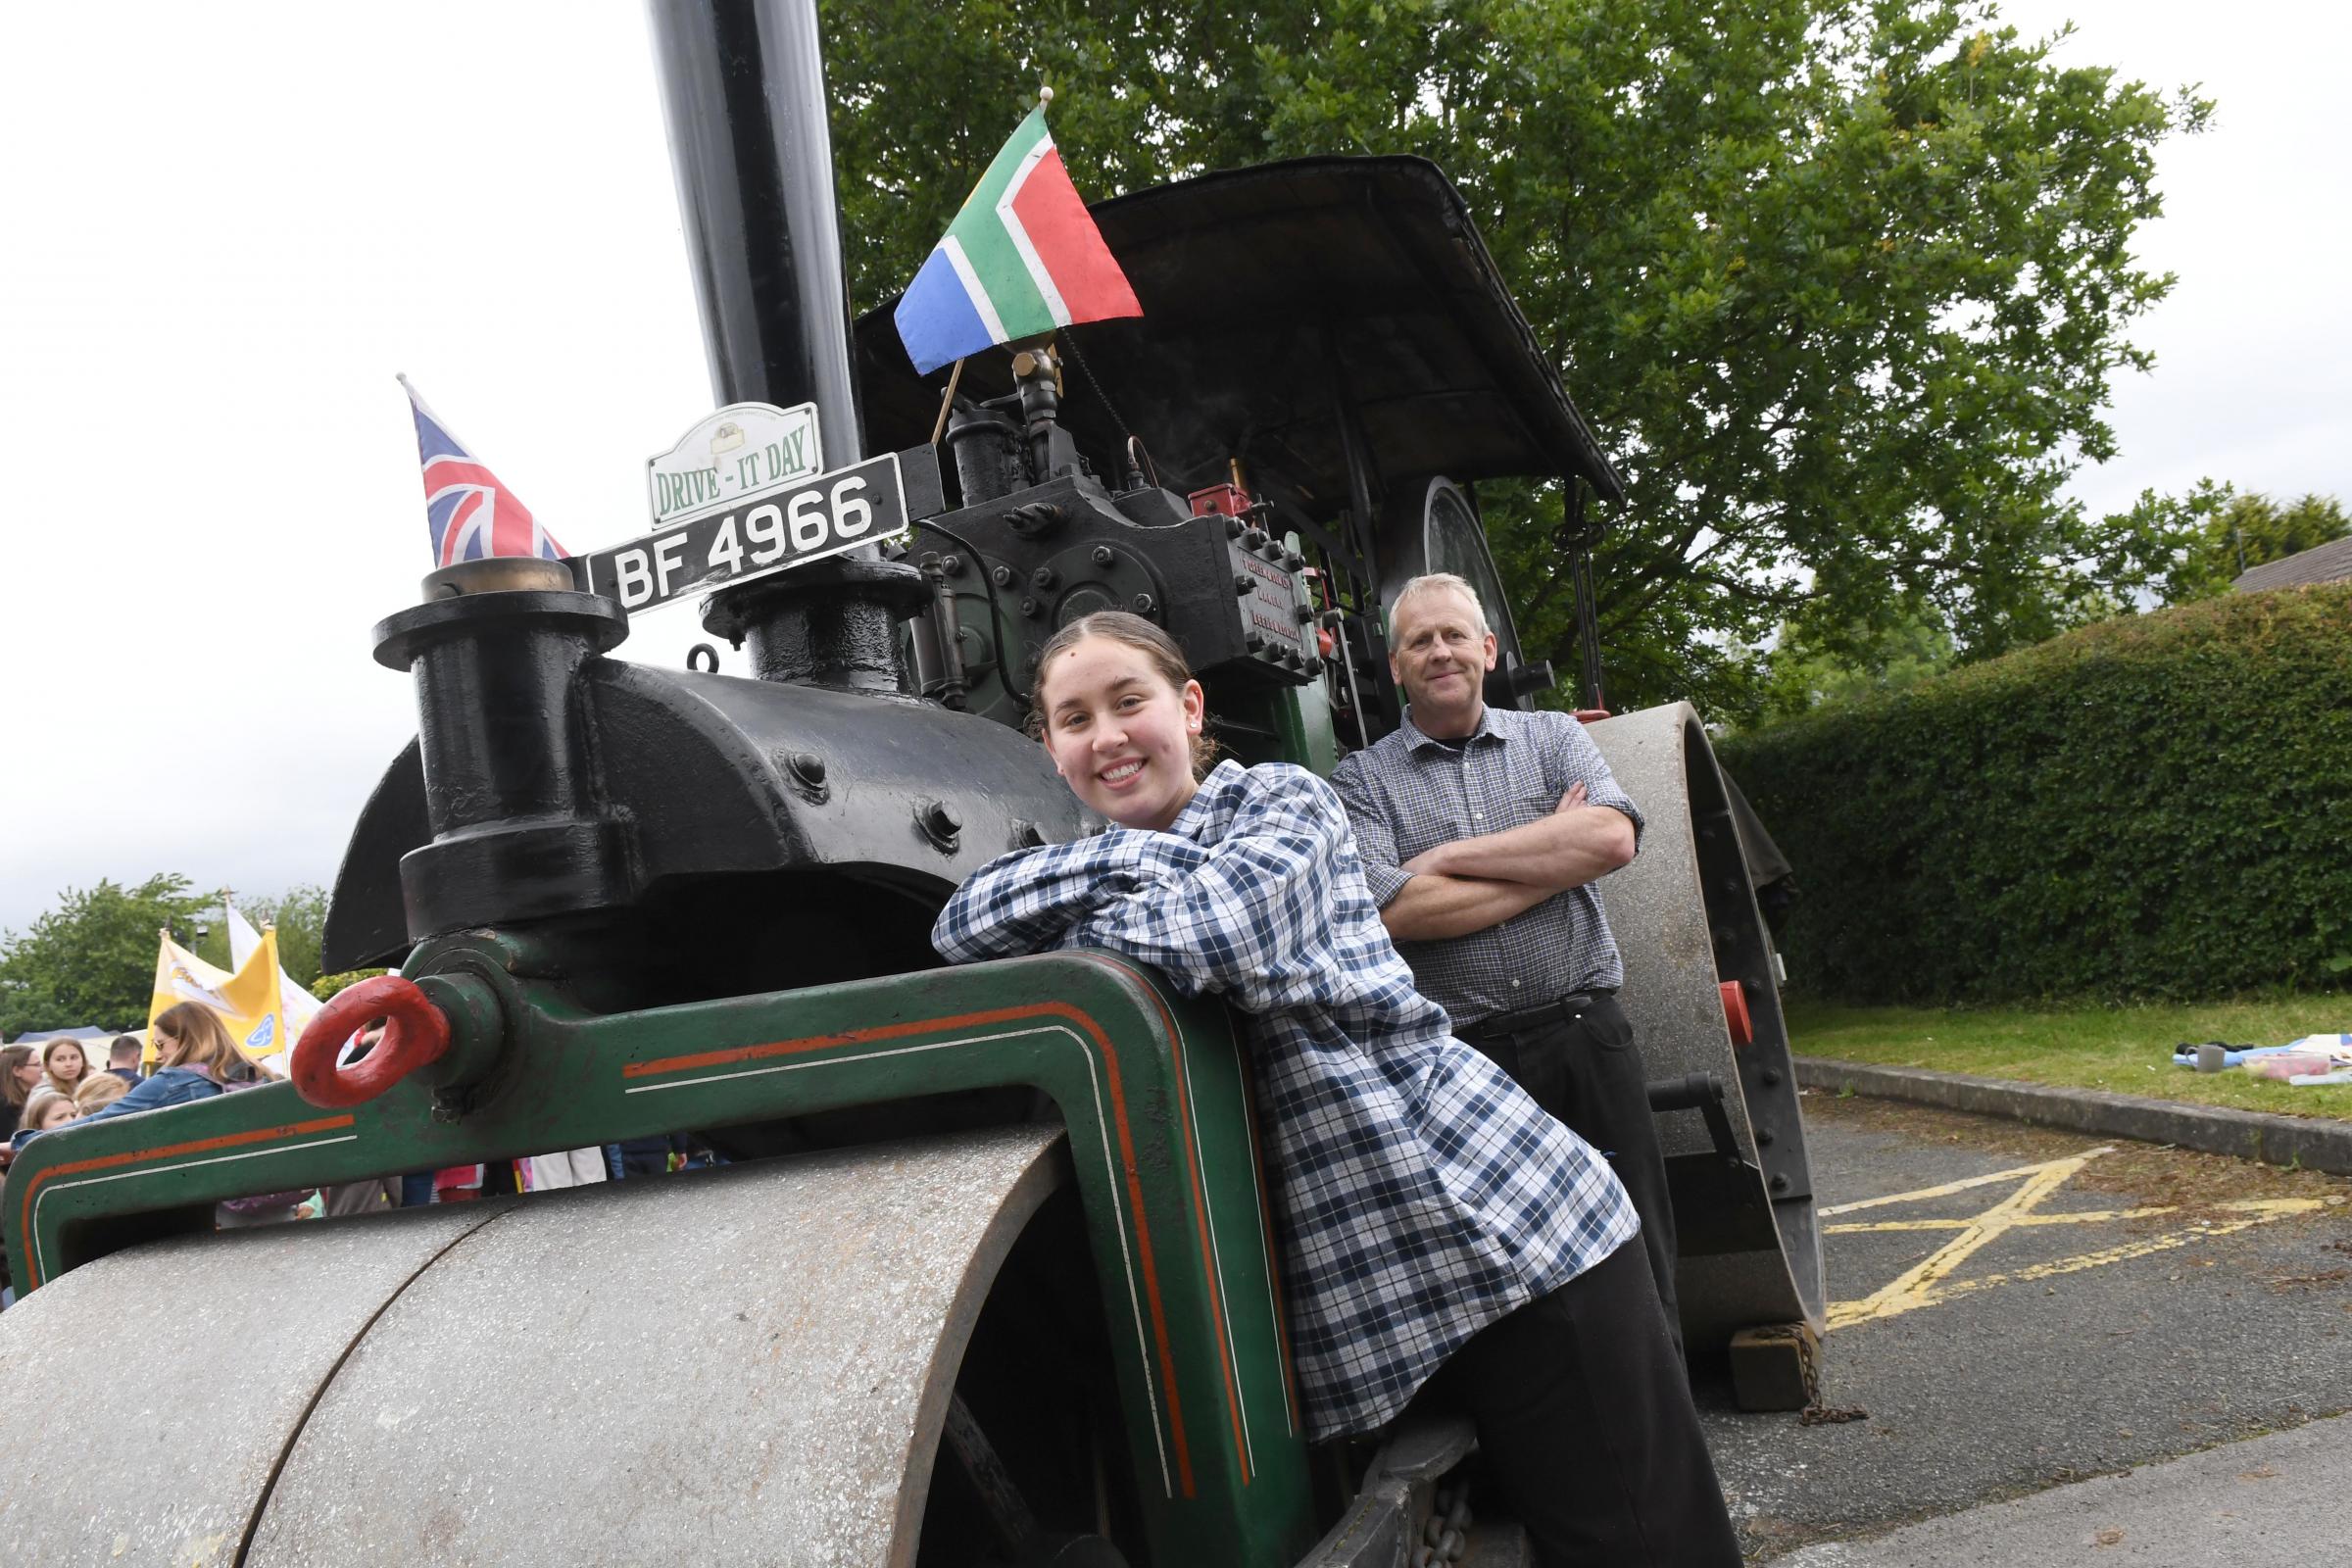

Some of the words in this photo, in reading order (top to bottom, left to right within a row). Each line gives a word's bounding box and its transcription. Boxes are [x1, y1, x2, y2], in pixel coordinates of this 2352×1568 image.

[656, 466, 719, 516] DRIVE
[736, 452, 760, 490] IT
[765, 424, 806, 480] DAY
[614, 532, 688, 609] BF
[708, 476, 872, 574] 4966
